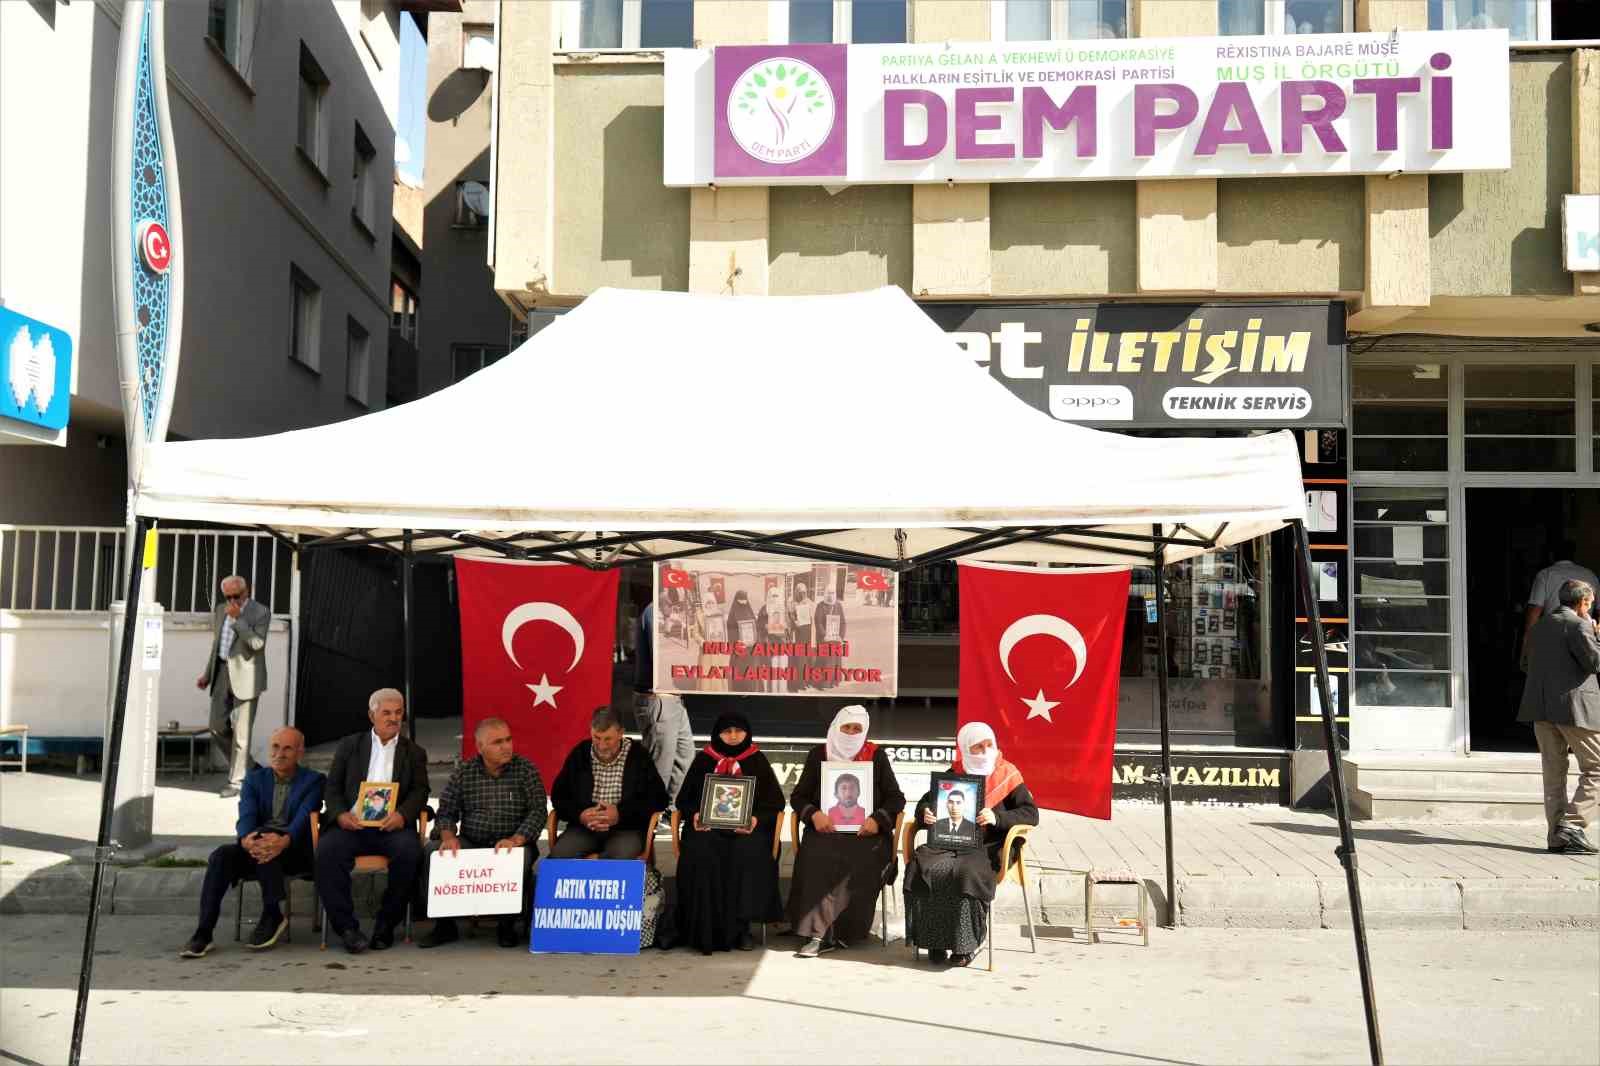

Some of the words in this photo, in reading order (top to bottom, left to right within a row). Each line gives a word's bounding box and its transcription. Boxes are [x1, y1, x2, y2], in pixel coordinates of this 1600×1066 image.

[938, 53, 984, 66] GELAN
[1301, 58, 1400, 80] ÖRGÜTÜ
[882, 73, 961, 85] HALKLARIN
[963, 68, 1014, 86] EŞİTLİK
[1017, 71, 1035, 83] VE
[1038, 66, 1117, 82] DEMOKRASİ
[1121, 65, 1175, 80] PARTİSİ
[883, 85, 1097, 162] DEM
[1133, 52, 1453, 157] PARTİ
[751, 141, 776, 158] DEM
[1067, 318, 1312, 384] İLETİŞİM
[1168, 392, 1238, 411] TEKNİK
[1241, 392, 1307, 411] SERVİS
[702, 641, 748, 660] MUŞ
[752, 639, 850, 658] ANNELERİ
[671, 664, 797, 682] EVLATLARINI
[1170, 766, 1281, 788] YAZILIM
[458, 868, 494, 880] EVLAT
[433, 881, 519, 897] NÖBETİNDEYİZ
[554, 878, 586, 900] ARTIK
[588, 879, 620, 900] YETER
[534, 907, 603, 930] YAKAMIZDAN
[606, 904, 643, 937] DÜŞÜN
